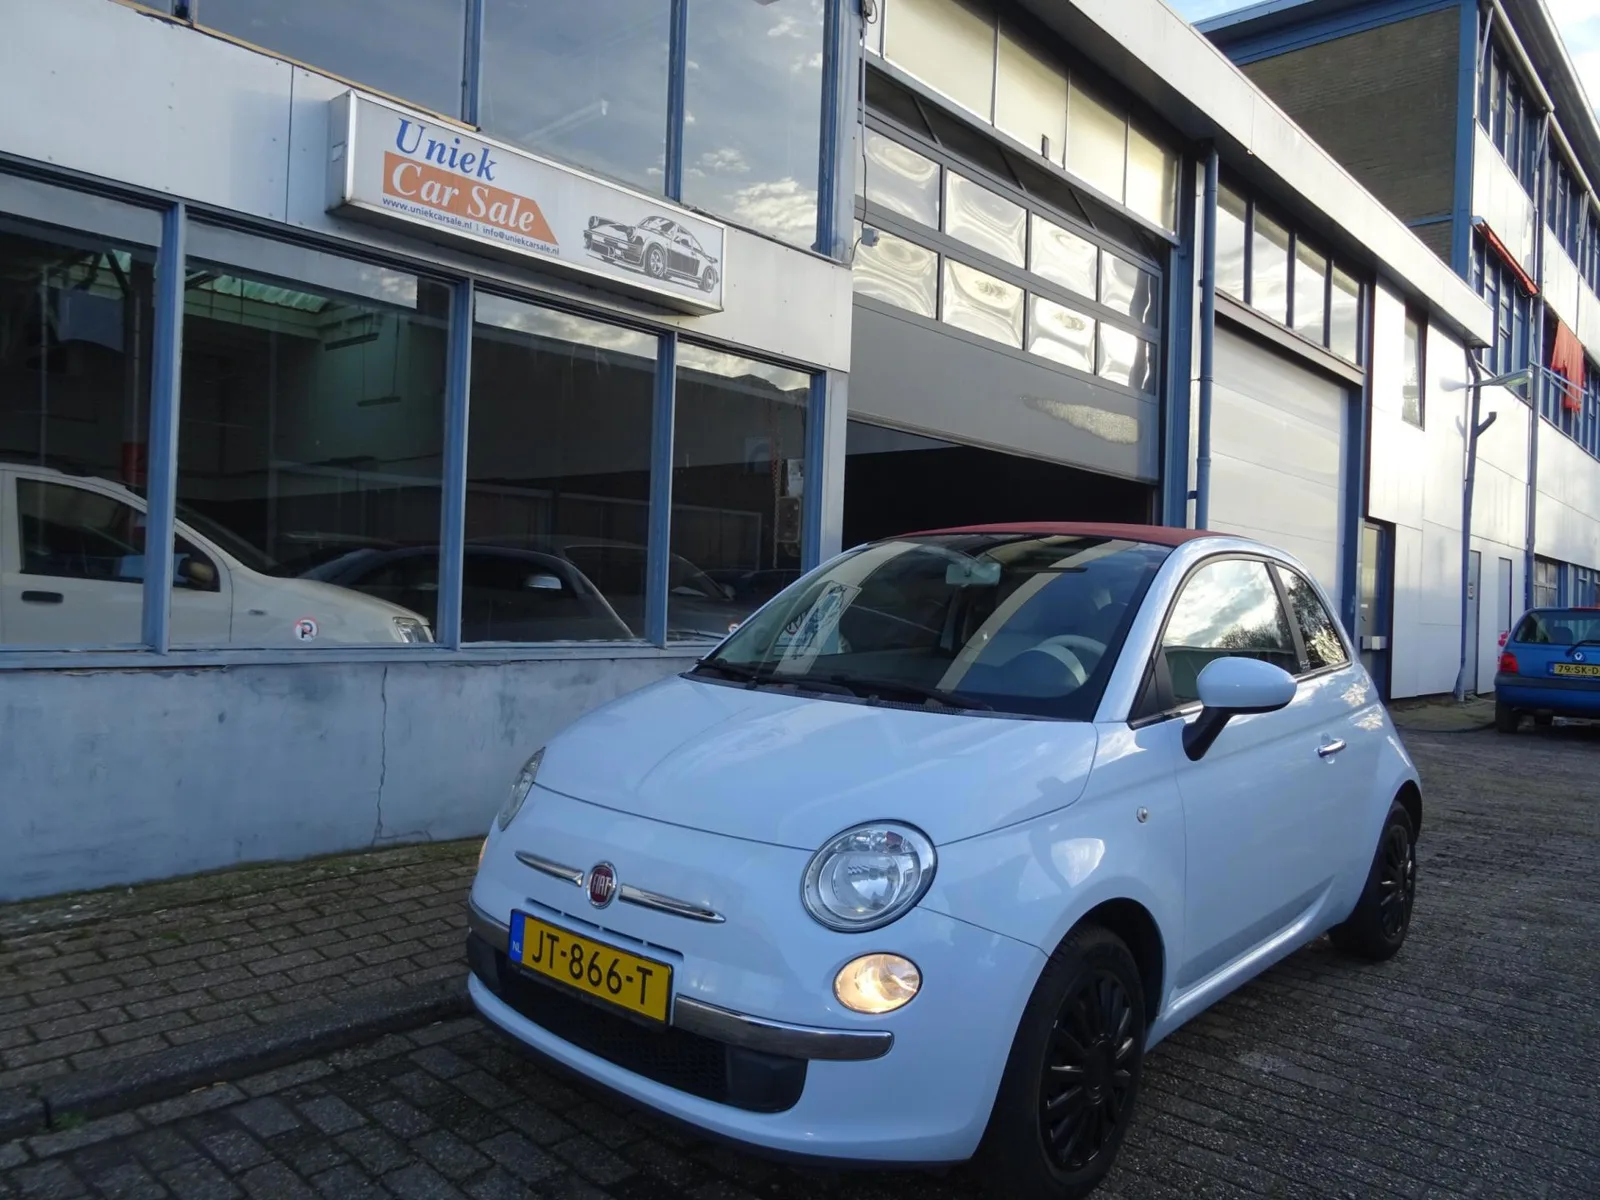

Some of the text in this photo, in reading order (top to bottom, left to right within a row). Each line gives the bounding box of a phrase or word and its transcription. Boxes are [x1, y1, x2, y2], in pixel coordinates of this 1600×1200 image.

[395, 117, 497, 182] Uniek
[382, 197, 472, 230] www.uniekcarsale.nl
[482, 226, 560, 256] info@uniekcarsale.nl
[392, 162, 535, 232] Car Sale
[1558, 664, 1600, 675] 79-SK-D
[591, 873, 612, 895] FIAT
[512, 940, 521, 953] NL
[532, 930, 653, 1006] JT-866-T
